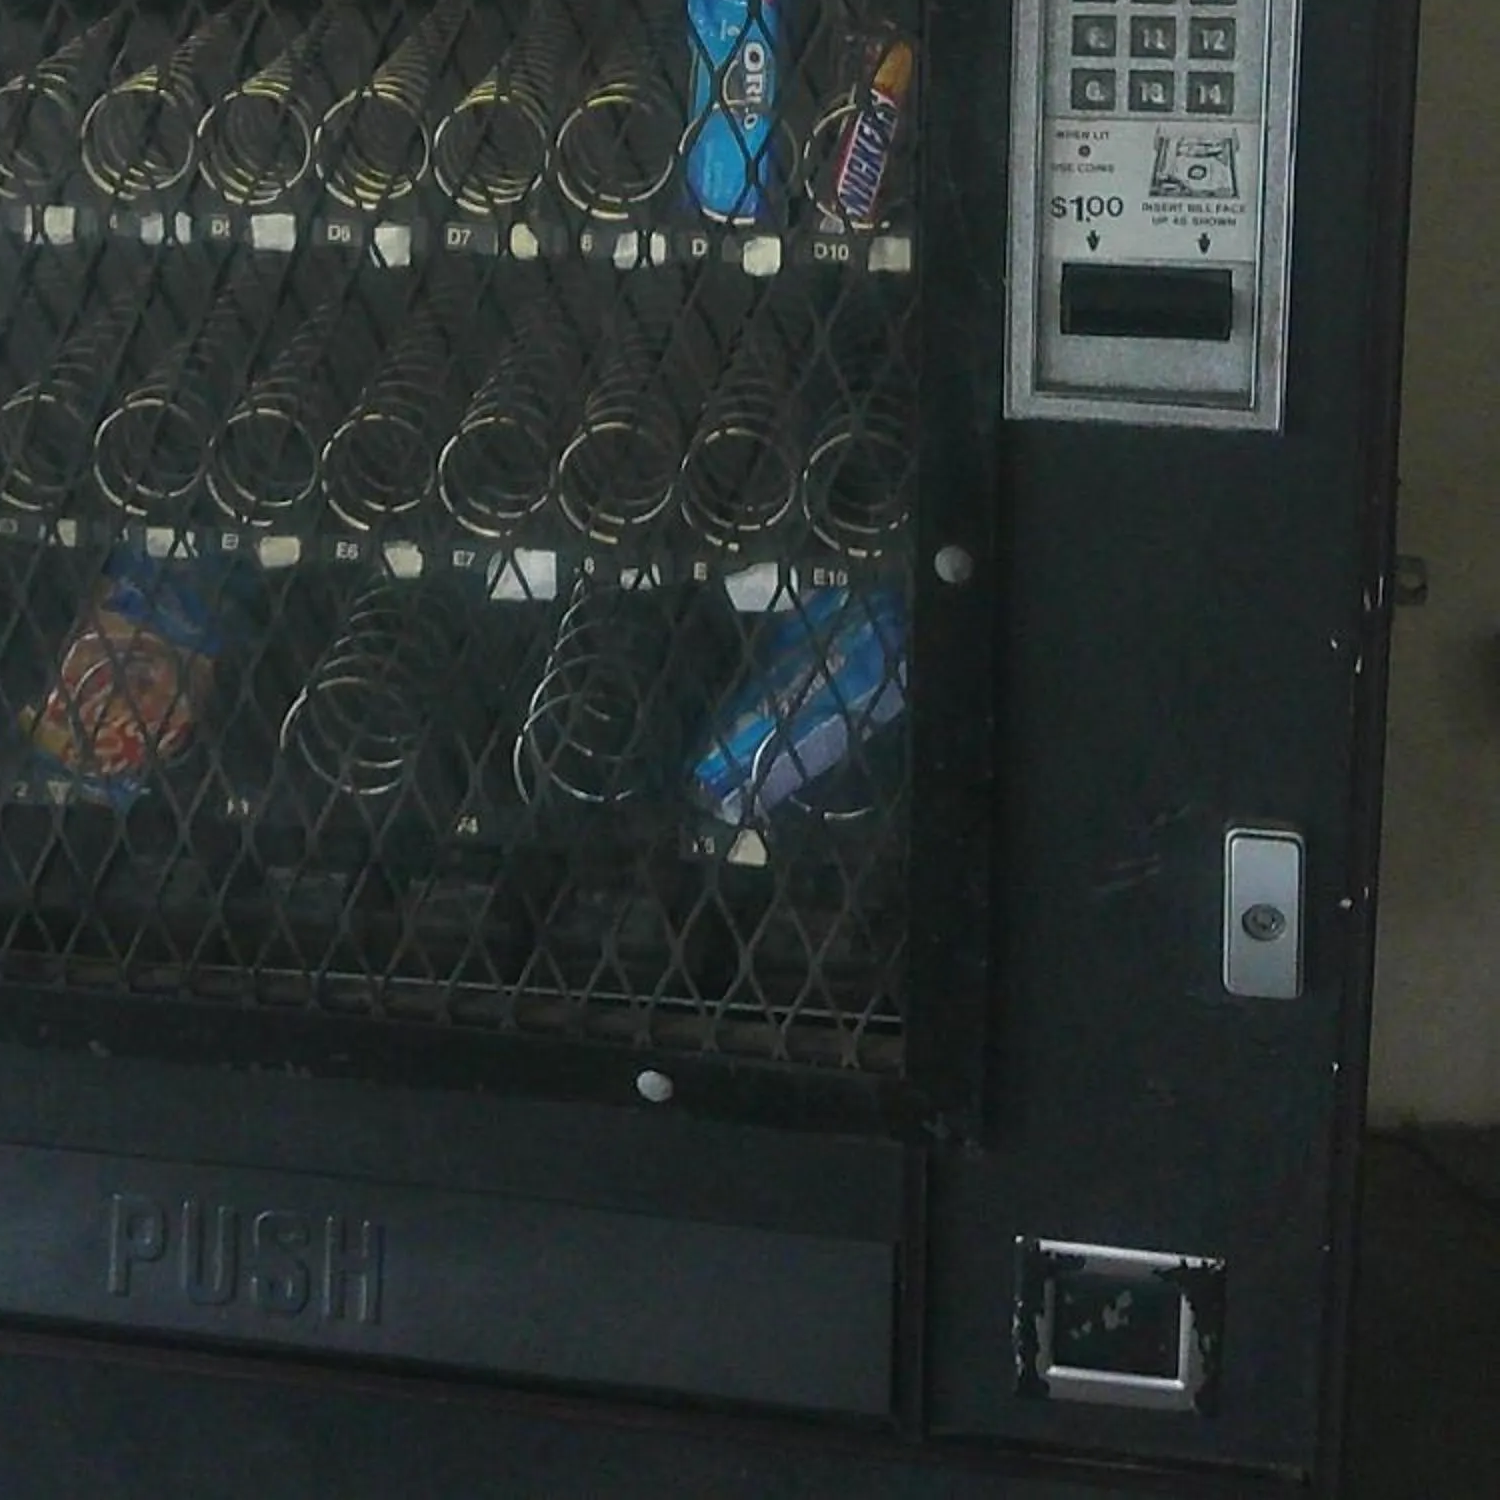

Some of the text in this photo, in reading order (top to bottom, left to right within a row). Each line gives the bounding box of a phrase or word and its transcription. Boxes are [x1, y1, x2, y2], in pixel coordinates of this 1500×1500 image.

[1202, 28, 1226, 51] 12
[1199, 82, 1222, 105] 14
[1050, 195, 1124, 222] $1.00
[1141, 202, 1183, 214] INSERT
[1215, 203, 1245, 214] FACE
[1192, 216, 1237, 227] SHOWN
[447, 227, 473, 247] D7
[814, 243, 849, 262] D10
[813, 567, 848, 586] E10
[106, 1192, 387, 1326] PUSH
